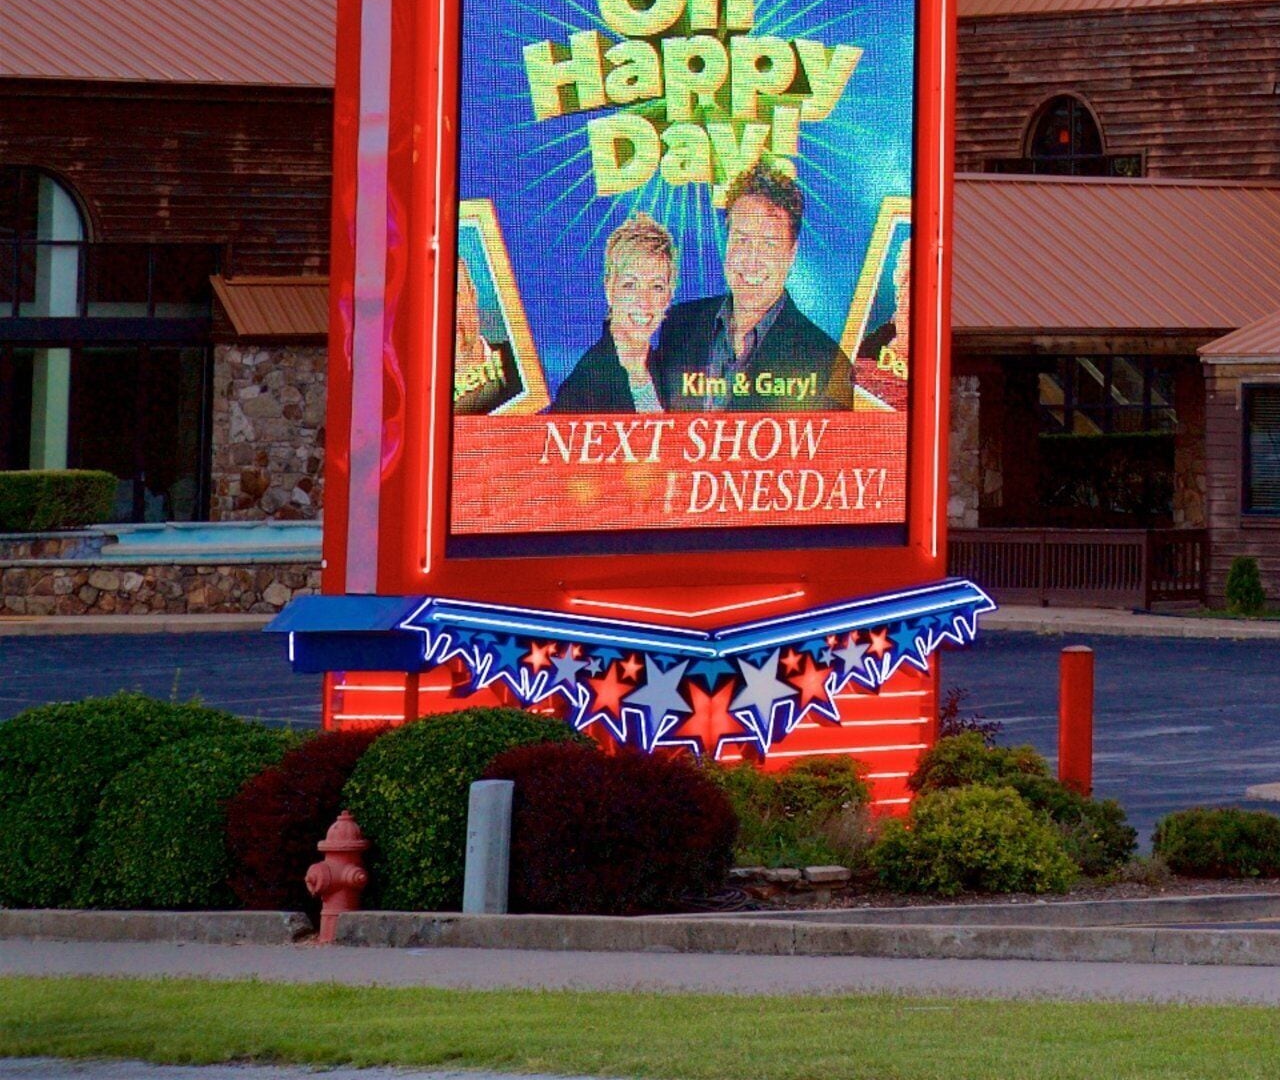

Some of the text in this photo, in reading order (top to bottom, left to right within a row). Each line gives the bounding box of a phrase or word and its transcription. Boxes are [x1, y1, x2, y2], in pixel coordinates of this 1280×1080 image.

[588, 105, 800, 208] Day!
[682, 372, 818, 401] Kim & Gary!
[538, 417, 830, 464] NEXT SHOW
